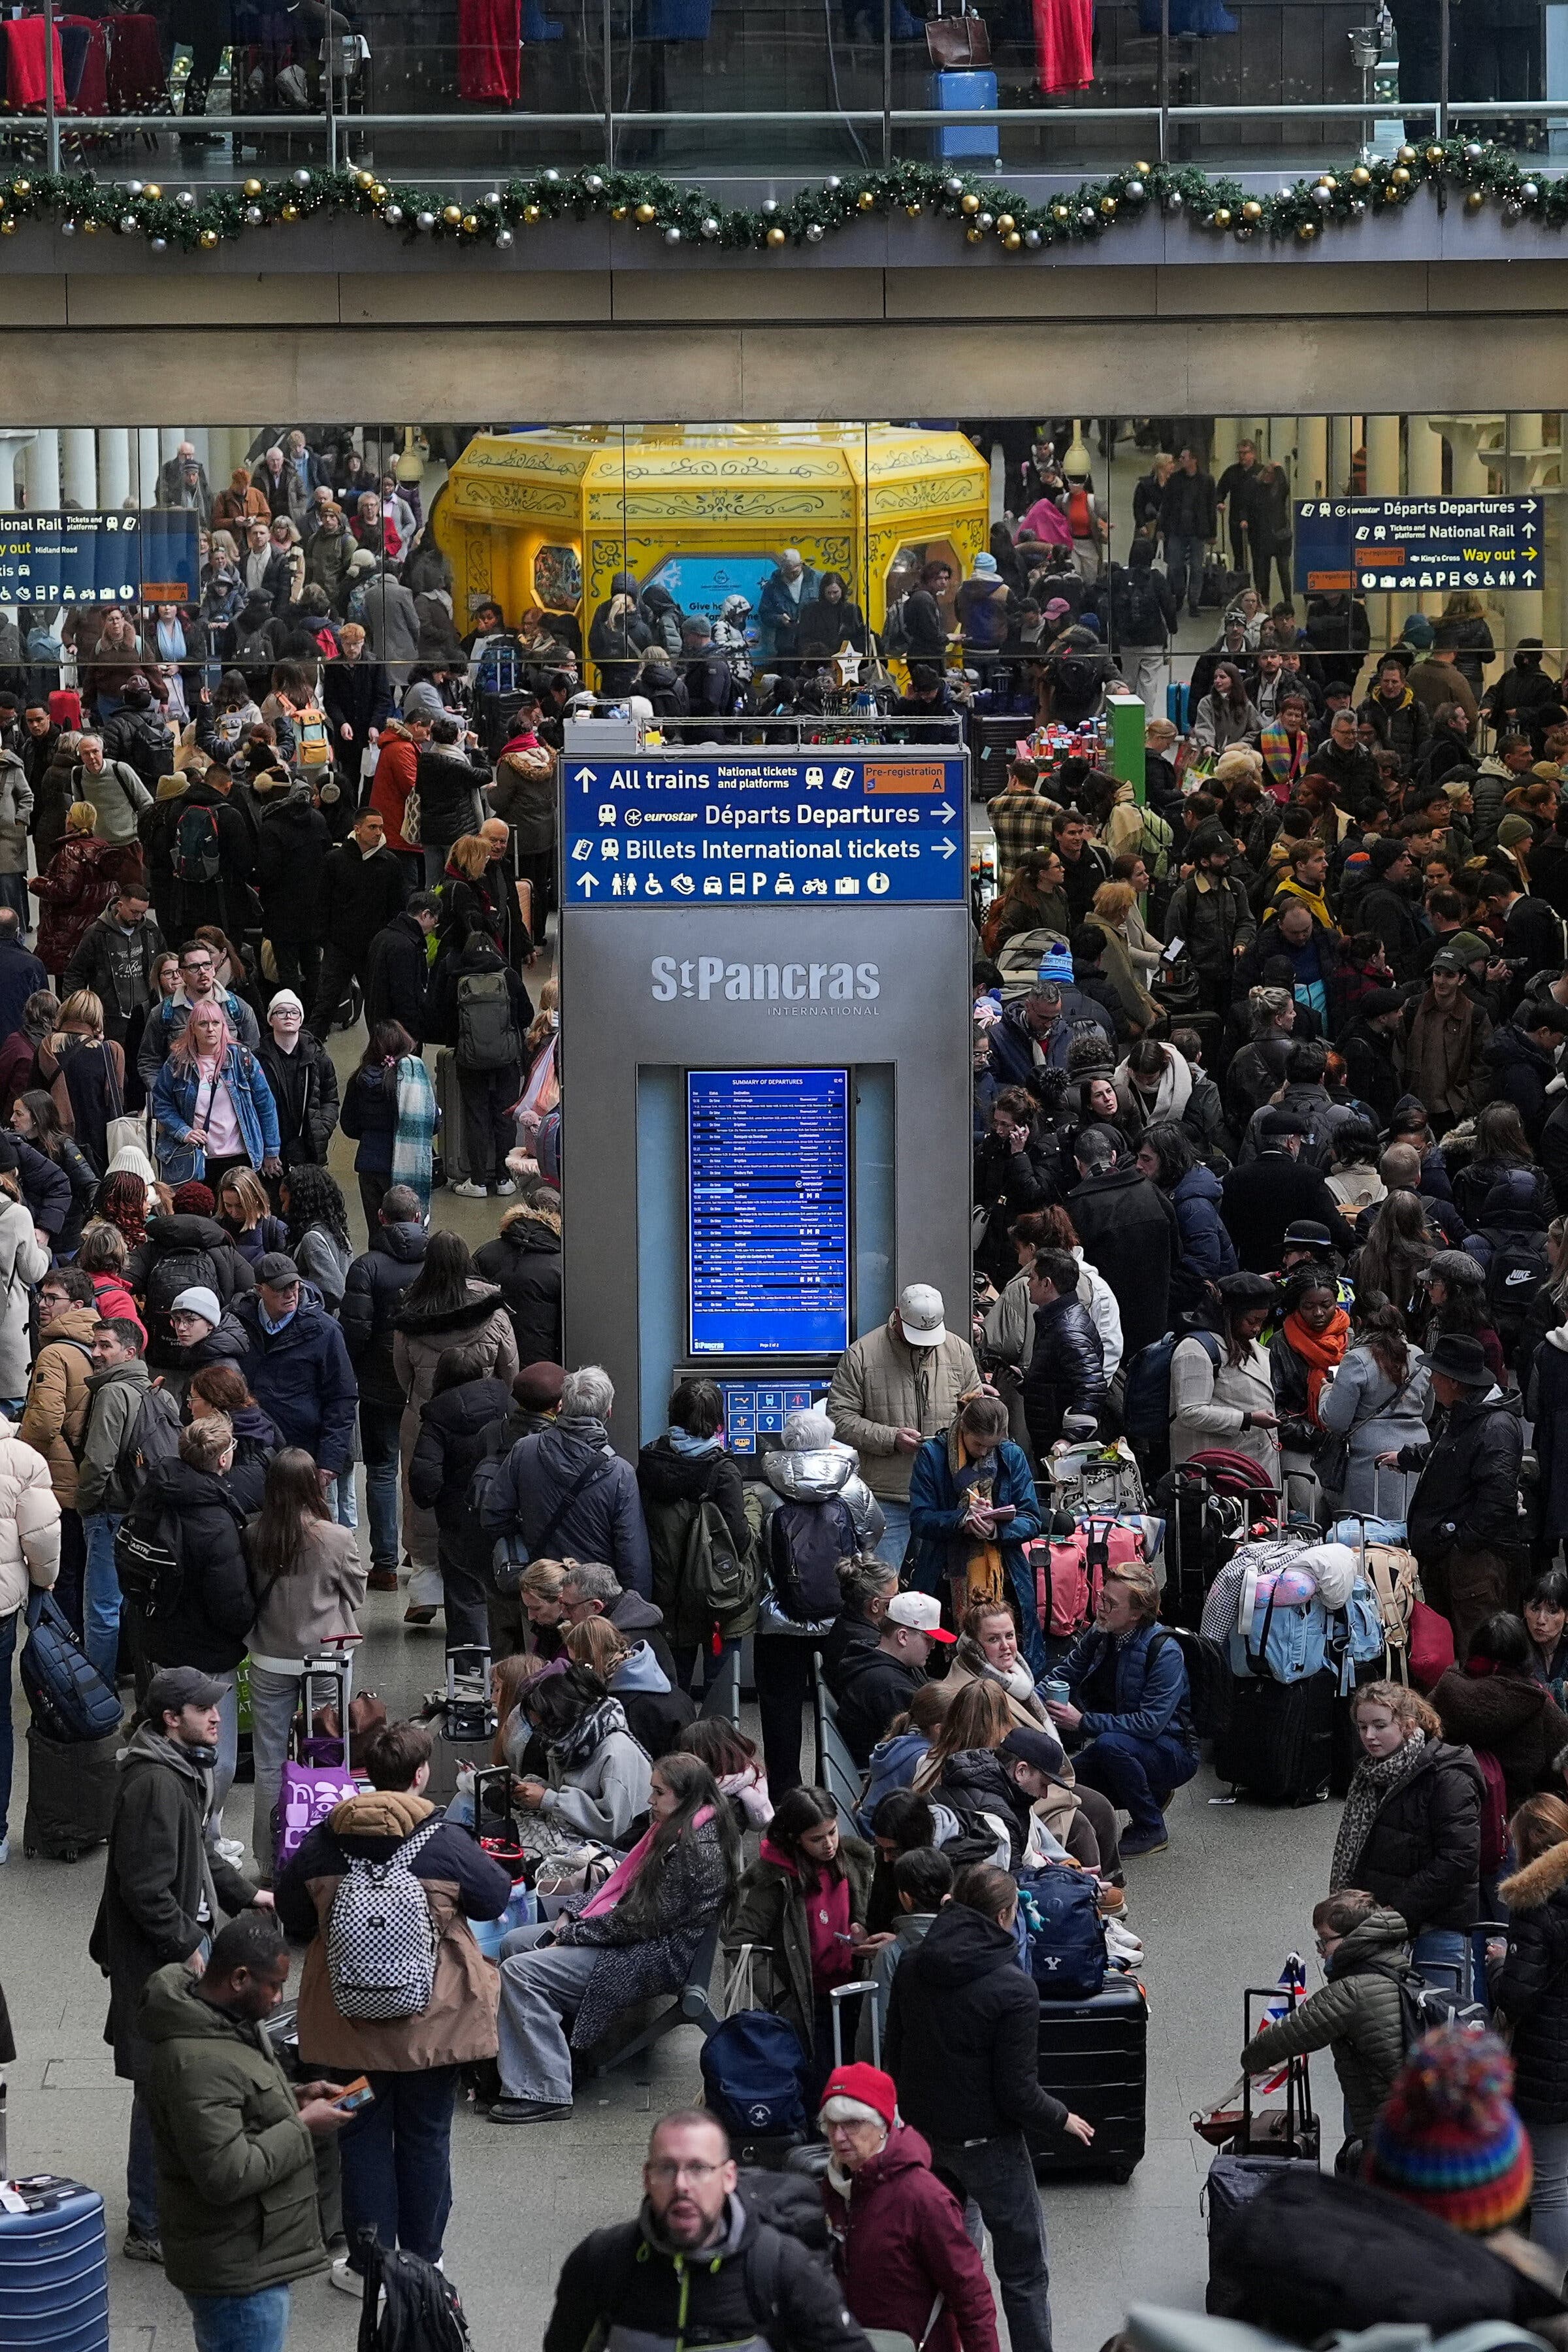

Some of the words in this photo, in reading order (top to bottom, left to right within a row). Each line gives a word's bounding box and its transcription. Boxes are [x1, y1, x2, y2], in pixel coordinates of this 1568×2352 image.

[1384, 501, 1437, 517] Départs
[1439, 501, 1515, 517] Departures
[37, 518, 63, 531] Rail
[1394, 532, 1426, 540] platforms
[1429, 525, 1486, 539] National
[1489, 525, 1516, 538] Rail
[10, 542, 31, 554] out
[1420, 555, 1441, 563] King's
[1442, 554, 1461, 563] Cross
[1463, 548, 1492, 564] Way
[1494, 549, 1516, 561] out
[718, 766, 760, 776] National
[763, 766, 798, 776] tickets
[866, 767, 942, 778] Pre-registration
[610, 770, 641, 789] All
[645, 770, 710, 789] trains
[717, 779, 737, 789] and
[740, 779, 789, 790] platforms
[932, 777, 942, 790] A
[644, 811, 698, 823] eurostar
[706, 802, 791, 829] Départs
[797, 804, 920, 828] Departures
[627, 840, 696, 860] Billets
[702, 839, 843, 859] International
[847, 838, 921, 858] tickets
[768, 1007, 879, 1017] INTERNATIONAL
[1510, 1269, 1531, 1279] NIKE
